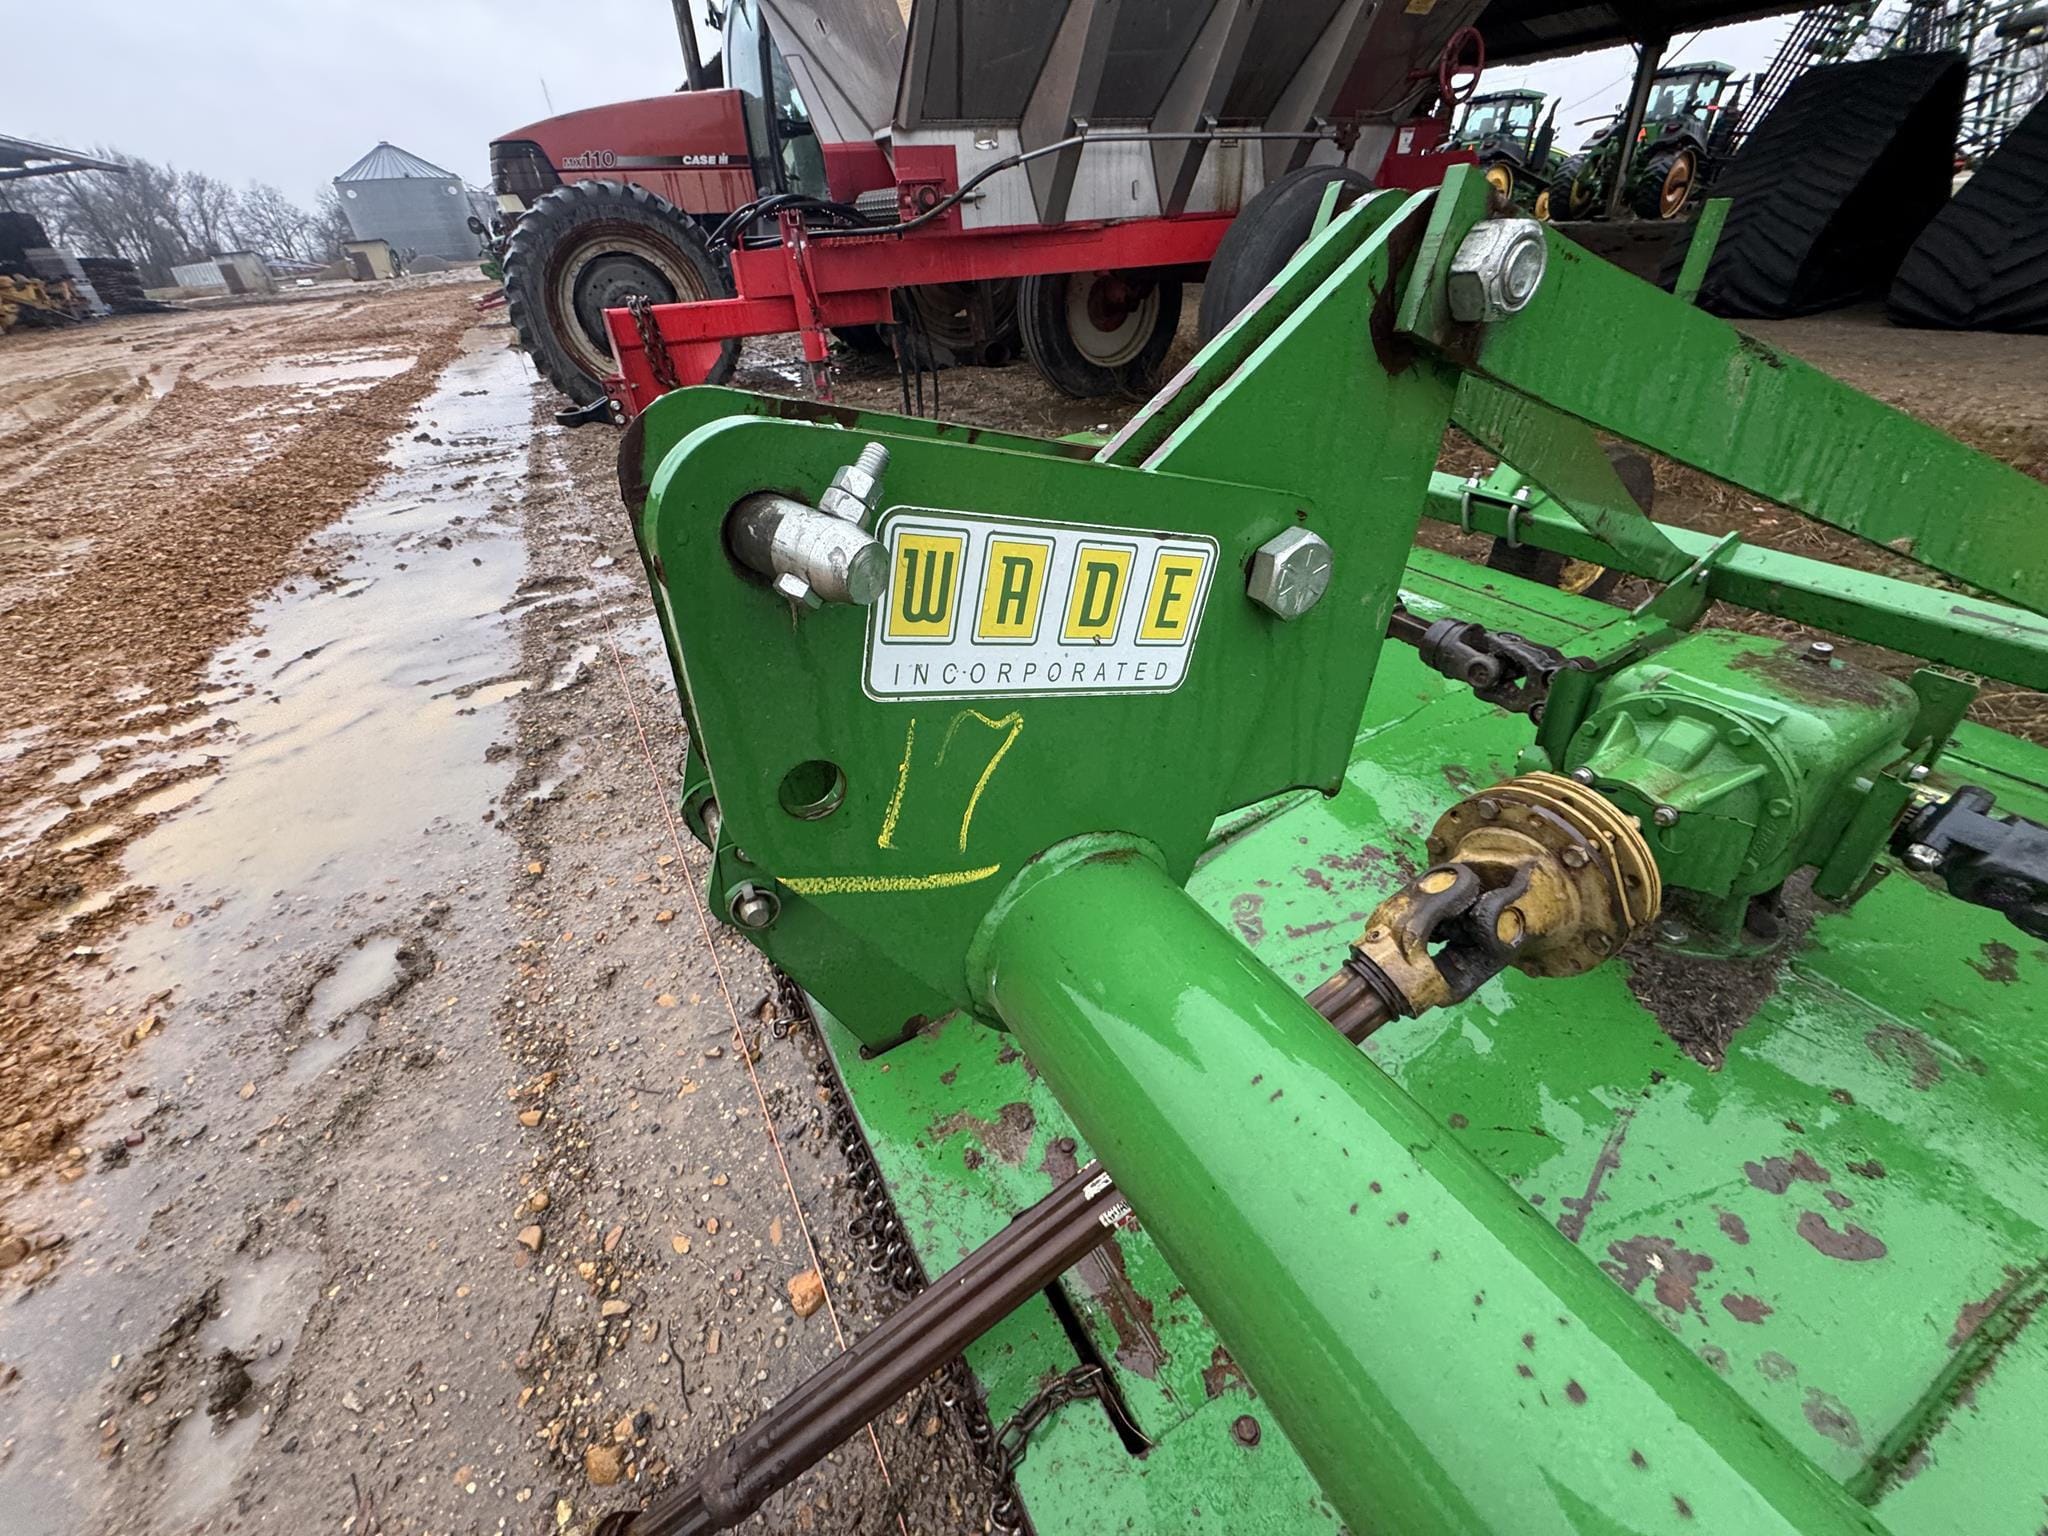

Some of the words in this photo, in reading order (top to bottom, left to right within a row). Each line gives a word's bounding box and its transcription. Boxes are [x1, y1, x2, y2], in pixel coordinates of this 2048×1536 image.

[682, 155, 716, 165] CASE
[902, 547, 1193, 629] WADE
[893, 661, 1170, 685] INCORPORATED
[878, 708, 1024, 853] 17
